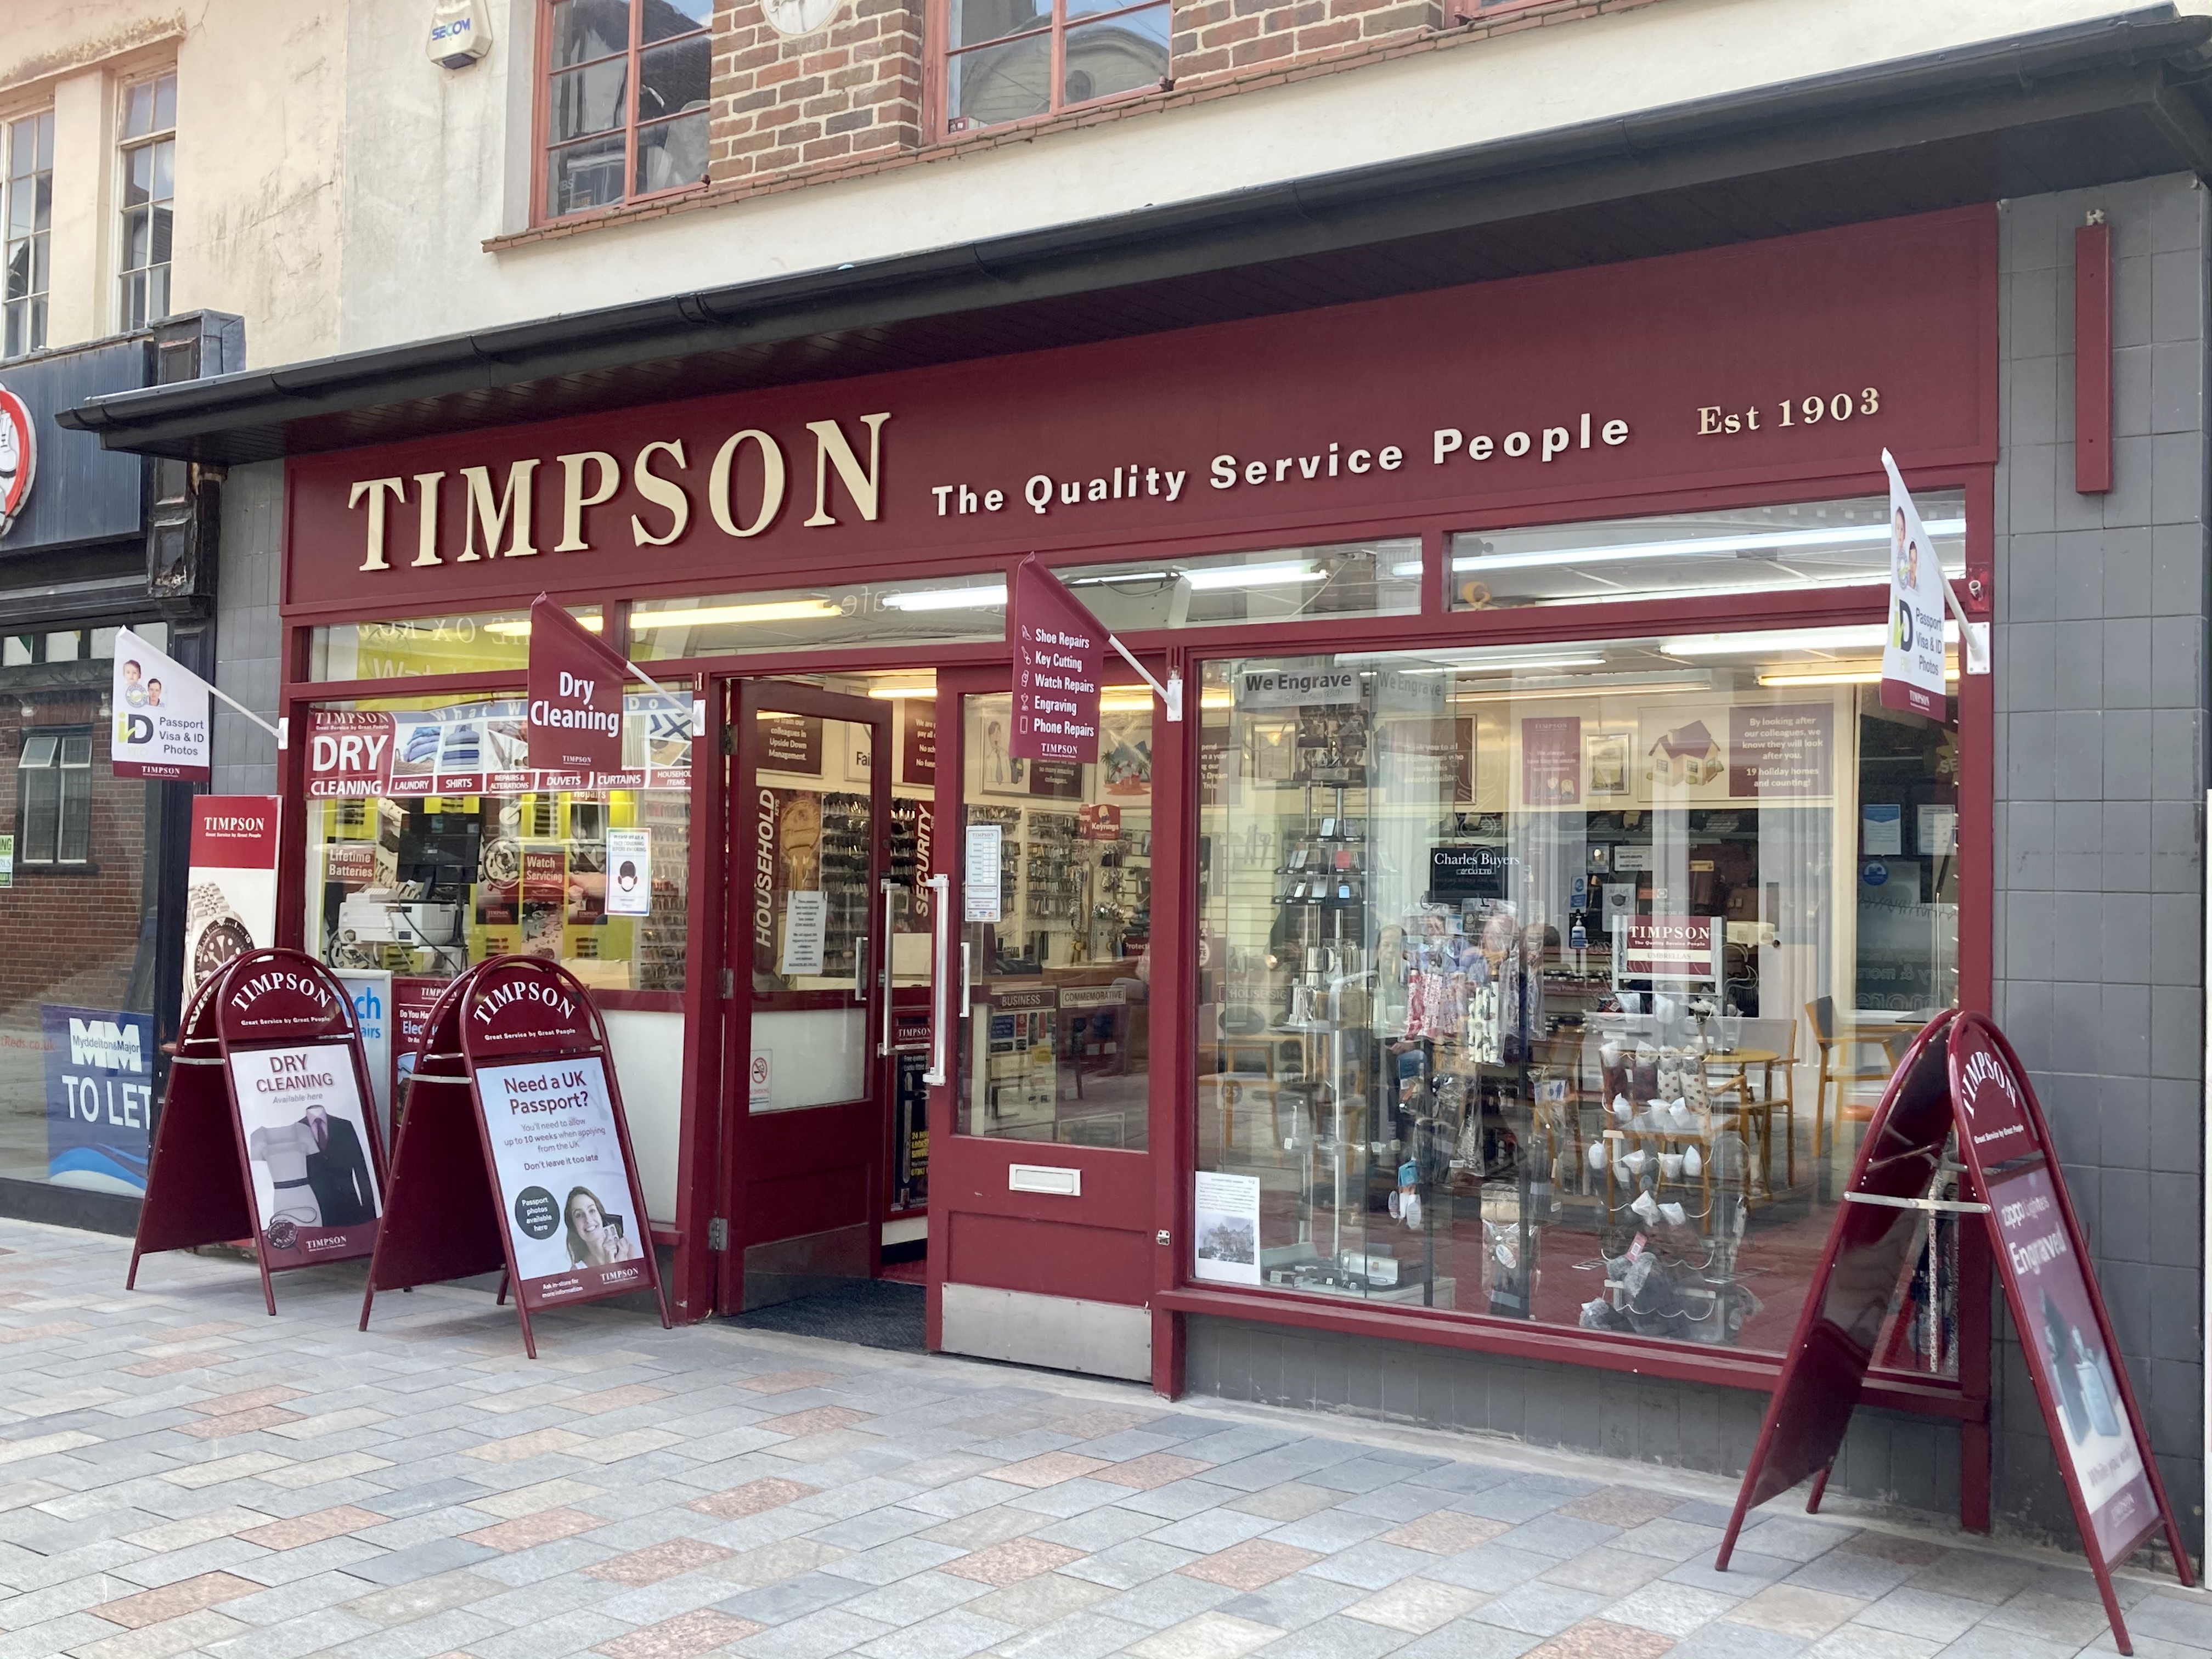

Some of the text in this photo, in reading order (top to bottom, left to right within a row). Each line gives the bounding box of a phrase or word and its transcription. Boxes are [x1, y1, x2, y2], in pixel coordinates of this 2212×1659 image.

[432, 18, 470, 41] SECOM
[1697, 387, 1880, 435] Est 1903
[932, 413, 1629, 516] The Quality Service People
[348, 412, 892, 571] TIMPSON
[1916, 607, 1942, 631] Passport
[1035, 628, 1090, 648] Shoe Repairs
[1916, 631, 1942, 654] Visa & ID
[1035, 651, 1082, 673] Key Cutting
[1918, 654, 1939, 676] Photos
[560, 671, 594, 705] Dry
[1035, 673, 1094, 694] Watch Repairs
[1246, 675, 1273, 691] We
[1278, 673, 1352, 693] Engrave
[1378, 672, 1396, 689] We
[1398, 677, 1441, 697] Engrave
[433, 704, 487, 721] What
[629, 697, 659, 710] Do
[1035, 695, 1077, 716] Engraving
[159, 717, 204, 730] Passport
[315, 713, 389, 725] TIMPSON
[531, 700, 619, 738] Cleaning
[1750, 716, 1816, 727] By looking after
[771, 727, 807, 738] colleagues in
[1034, 718, 1094, 738] Phone Repairs
[1760, 729, 1807, 738] colleagues,
[159, 731, 204, 743] Visa & ID
[769, 737, 808, 749] Upside Down
[1767, 740, 1787, 749] they
[1804, 738, 1823, 747] look
[163, 744, 199, 756] Photos
[312, 735, 389, 772] DRY
[1041, 743, 1077, 754] TIMPSON
[1763, 752, 1802, 760] after you.
[142, 765, 180, 775] TIMPSON
[1759, 768, 1790, 777] holiday
[1791, 767, 1819, 775] homes
[394, 780, 430, 791] LAUNDRY
[445, 778, 473, 788] SHIRTS
[490, 782, 529, 790] ALTERATIONS
[546, 776, 582, 786] DUVETS
[597, 775, 641, 785] CURTAINS
[1771, 778, 1811, 788] counting!
[311, 780, 382, 795] CLEANING
[204, 817, 265, 831] TIMPSON
[1091, 822, 1119, 831] Keyrings
[329, 849, 371, 863] Lifetime
[527, 856, 555, 868] Watch
[916, 803, 932, 917] SECURITY
[1434, 853, 1520, 868] Charles Buyers
[329, 864, 373, 878] Batteries
[755, 789, 775, 947] HOUSEHOLD
[526, 870, 562, 883] Servicing
[1628, 926, 1711, 939] TIMPSON
[231, 972, 332, 1012] TIMPSON
[1064, 990, 1123, 1002] COMMEMORATIVE
[473, 981, 576, 1026] TIMPSON
[1001, 994, 1041, 1006] BUSINESS
[528, 1031, 537, 1039] by
[556, 1028, 576, 1037] People
[269, 1053, 308, 1073] DRY
[256, 1073, 335, 1093] CLEANING
[504, 1070, 588, 1094] Need a UK
[1961, 1051, 2016, 1120] TIMPSON
[61, 1075, 152, 1130] TO LET
[273, 1093, 323, 1104] Available here
[510, 1091, 589, 1115] Passport?
[521, 1122, 540, 1132] You'll
[541, 1121, 558, 1130] need
[568, 1118, 586, 1127] allow
[504, 1138, 514, 1147] up
[524, 1135, 534, 1143] 10
[534, 1133, 558, 1142] weeks
[558, 1129, 577, 1139] when
[578, 1126, 606, 1138] applying
[537, 1144, 556, 1153] from
[569, 1141, 580, 1149] UK
[524, 1154, 599, 1171] Don't leave it too late
[521, 1197, 549, 1207] Passport
[526, 1206, 548, 1216] photos
[526, 1214, 552, 1224] available
[306, 1234, 347, 1249] TIMPSON
[600, 1267, 639, 1282] TIMPSON
[552, 1280, 571, 1288] in-store
[556, 1286, 584, 1296] information
